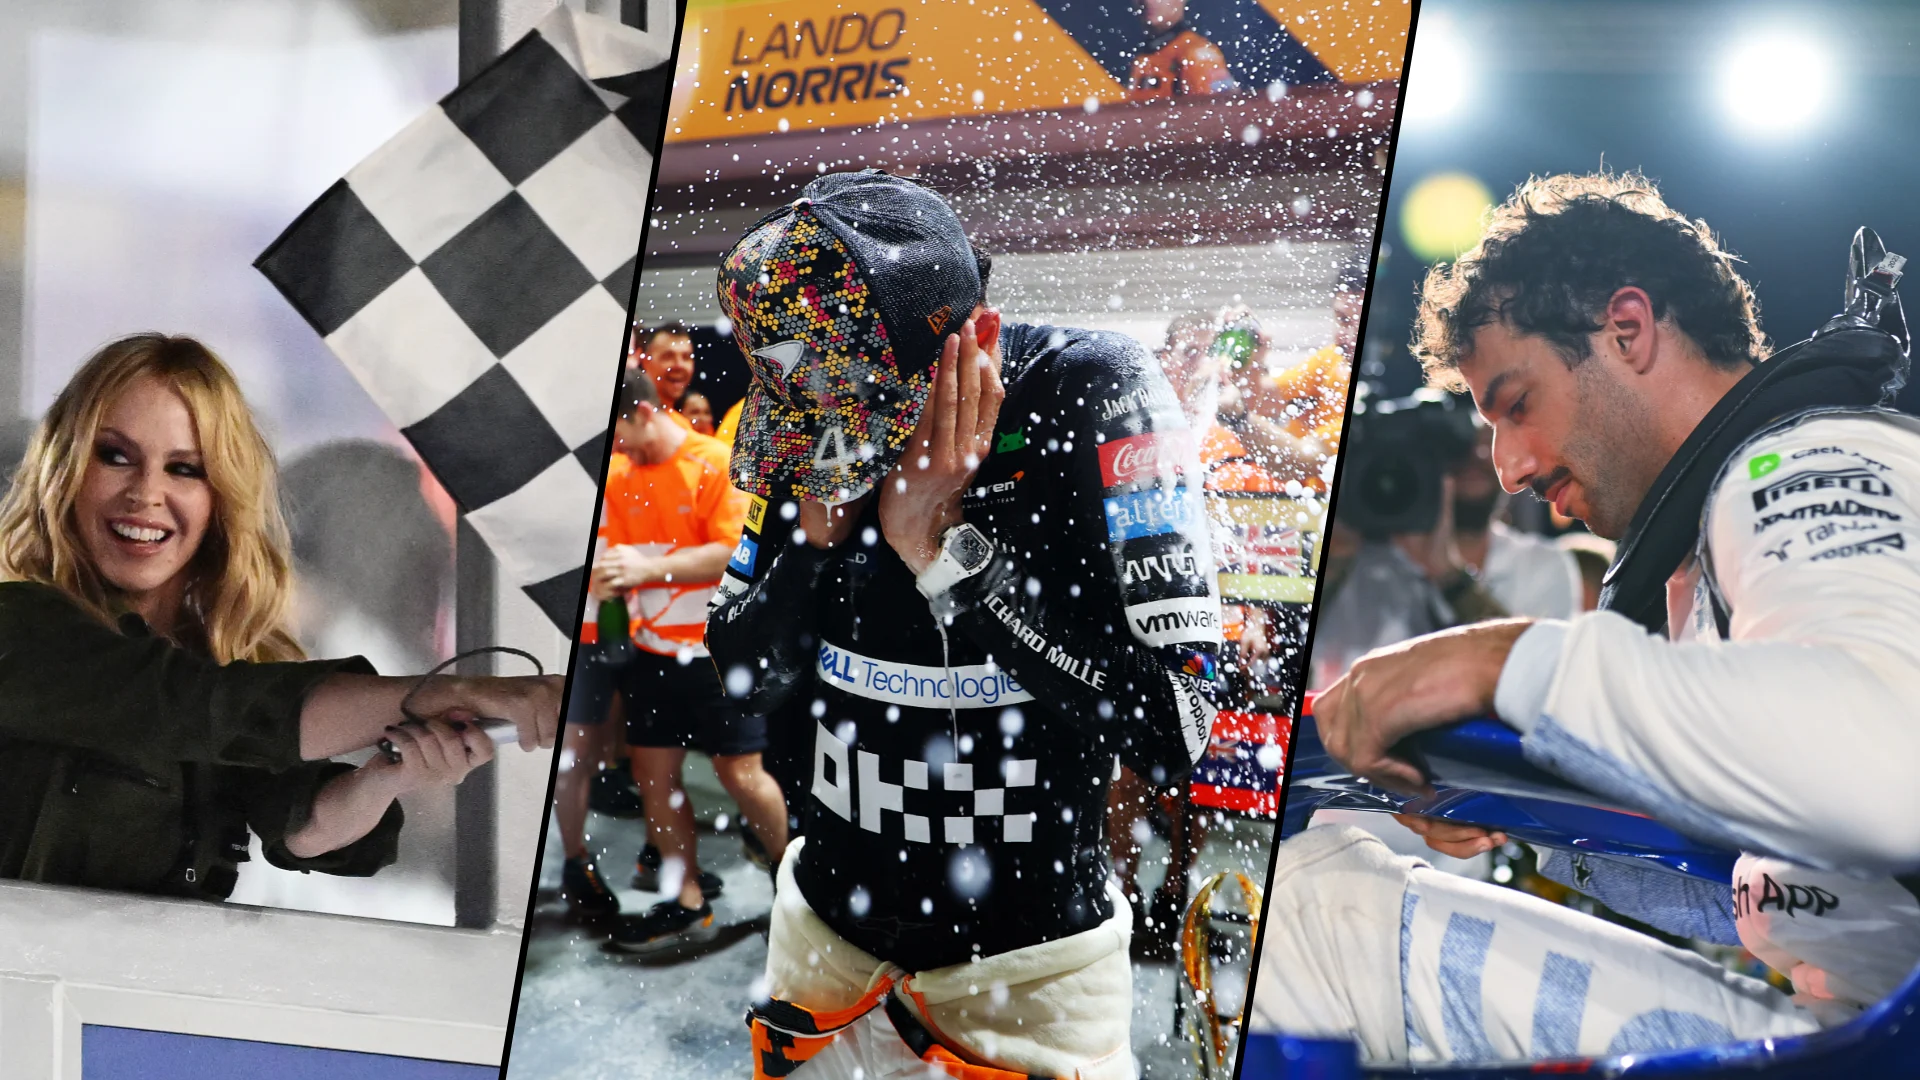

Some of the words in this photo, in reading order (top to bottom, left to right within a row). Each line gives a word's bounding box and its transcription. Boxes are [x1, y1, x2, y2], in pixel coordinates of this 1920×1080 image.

[732, 8, 906, 66] LANDO
[724, 58, 911, 113] NORRIS
[1101, 392, 1138, 421] JACK
[814, 426, 856, 476] 4
[983, 592, 1047, 653] ICHARD
[1045, 646, 1108, 691] MILLE
[819, 645, 856, 684] ELL
[862, 660, 1024, 703] Technologie
[1757, 873, 1840, 918] App
